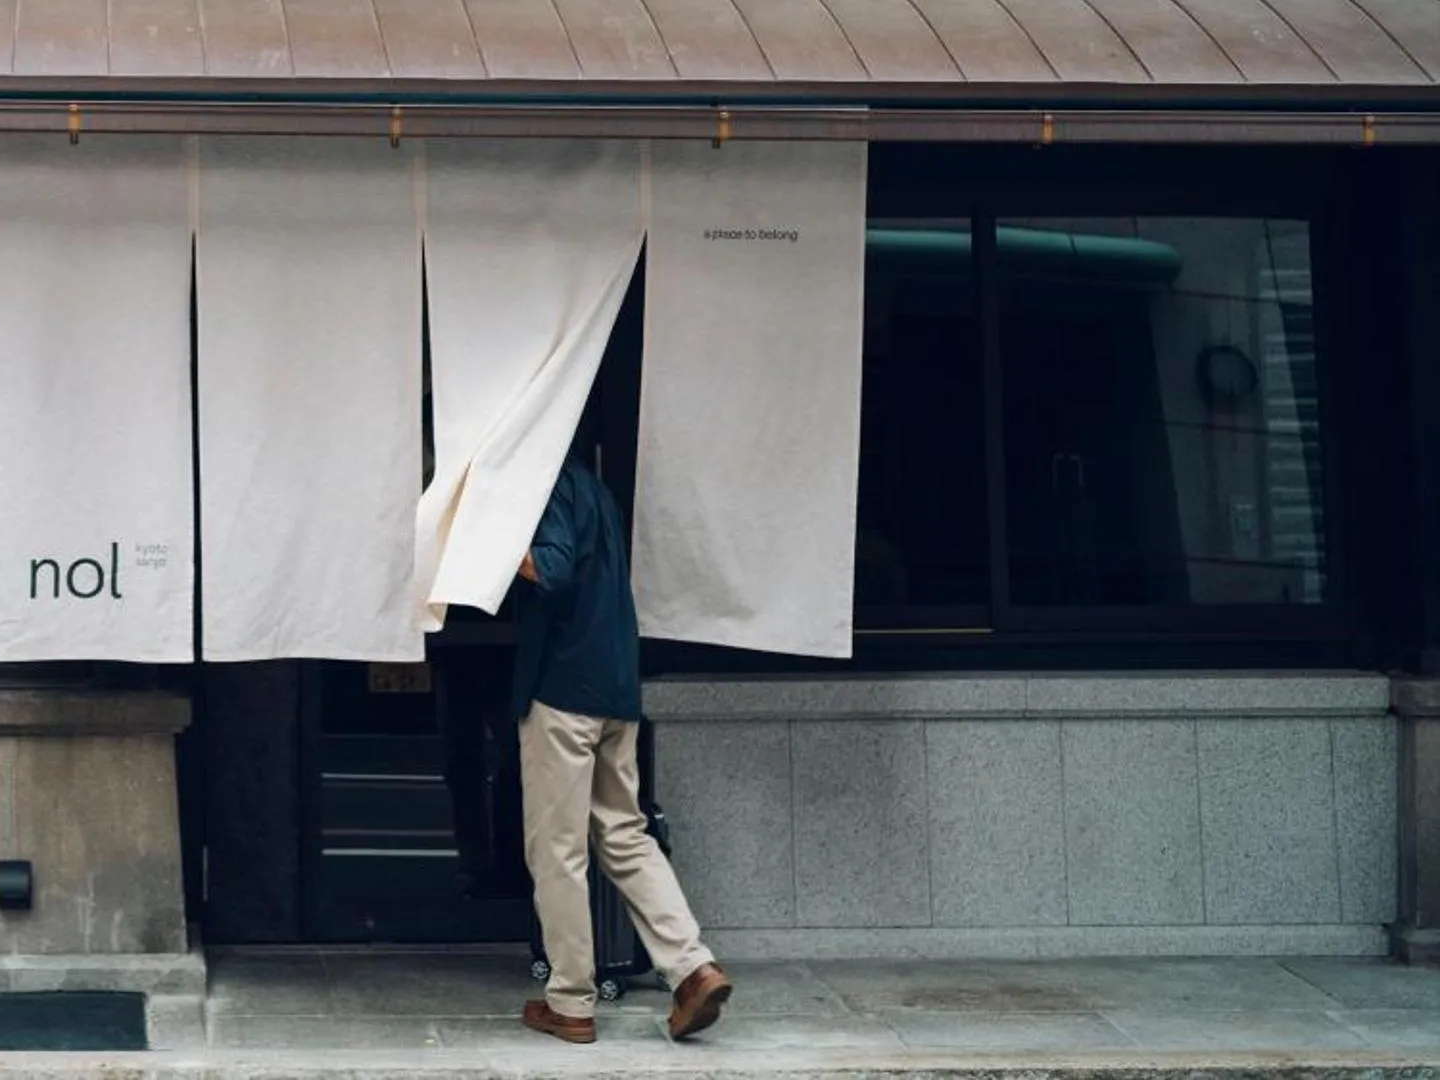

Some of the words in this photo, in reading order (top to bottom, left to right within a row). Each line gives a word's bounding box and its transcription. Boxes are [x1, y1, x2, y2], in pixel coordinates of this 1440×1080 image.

[712, 228, 742, 241] place
[745, 228, 758, 240] to
[759, 228, 798, 242] belong
[135, 543, 169, 556] kyoto
[30, 542, 122, 599] nol
